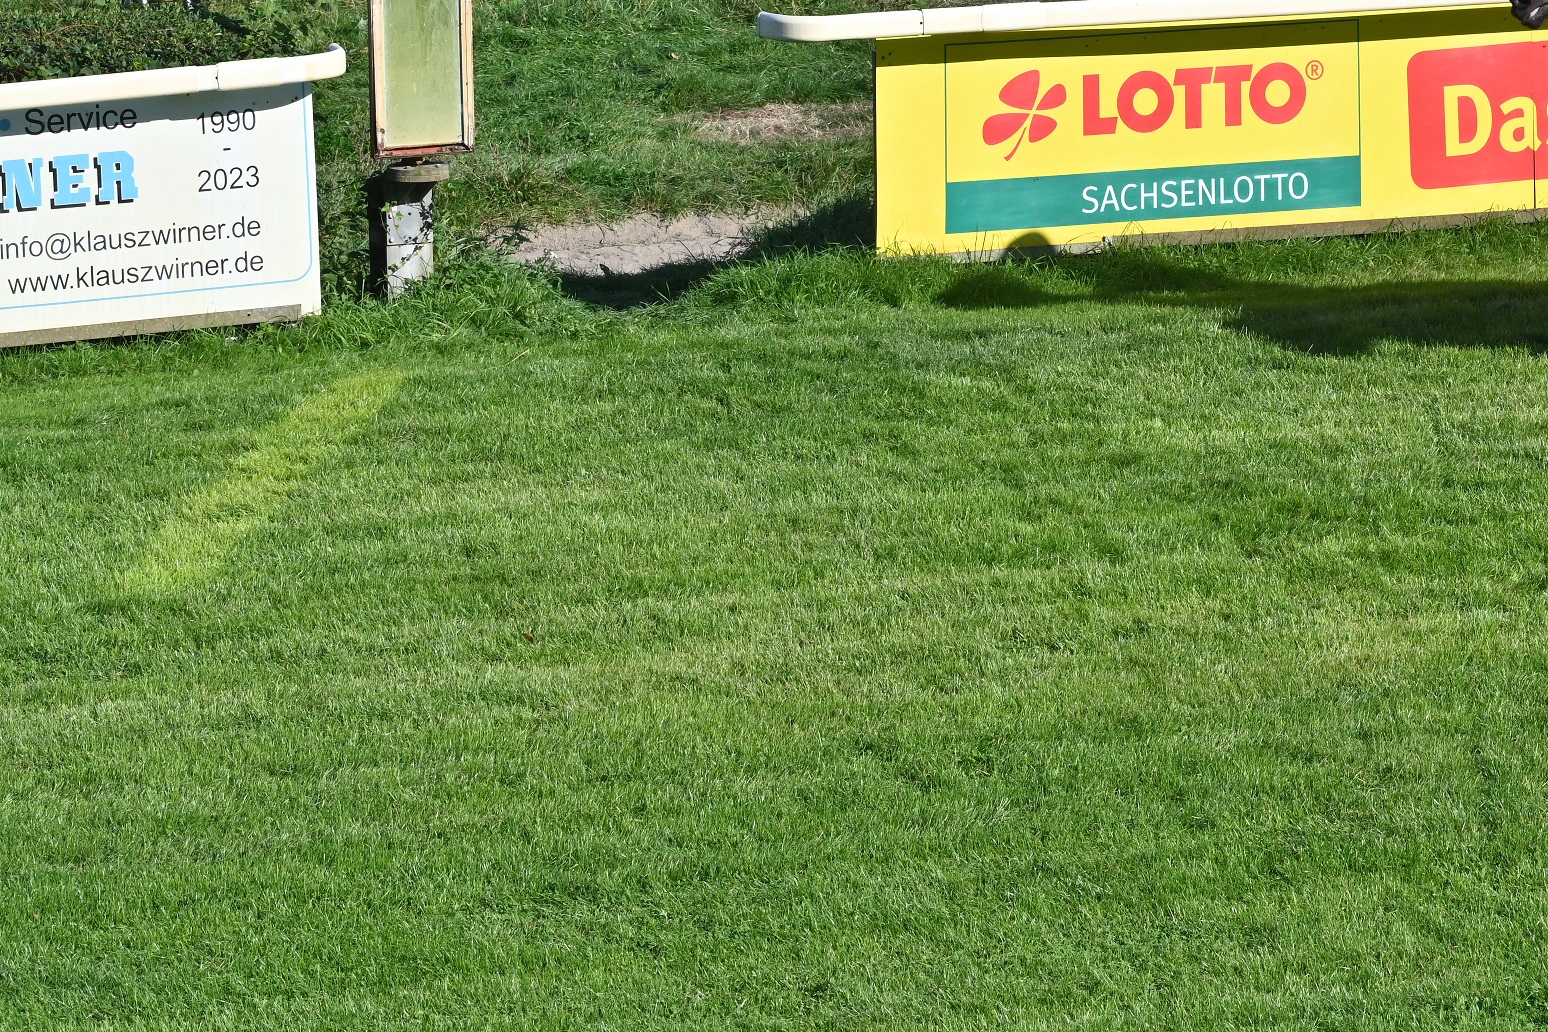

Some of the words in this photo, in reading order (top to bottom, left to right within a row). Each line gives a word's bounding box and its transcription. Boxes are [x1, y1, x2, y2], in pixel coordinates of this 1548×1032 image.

[24, 104, 138, 136] Service
[196, 108, 256, 135] 1990
[0, 150, 138, 214] NER
[197, 165, 261, 193] 2023
[1082, 172, 1309, 214] SACHSENLOTTO
[0, 216, 261, 261] info@klauszwirner.de
[8, 251, 264, 295] www.klauszwirner.de
